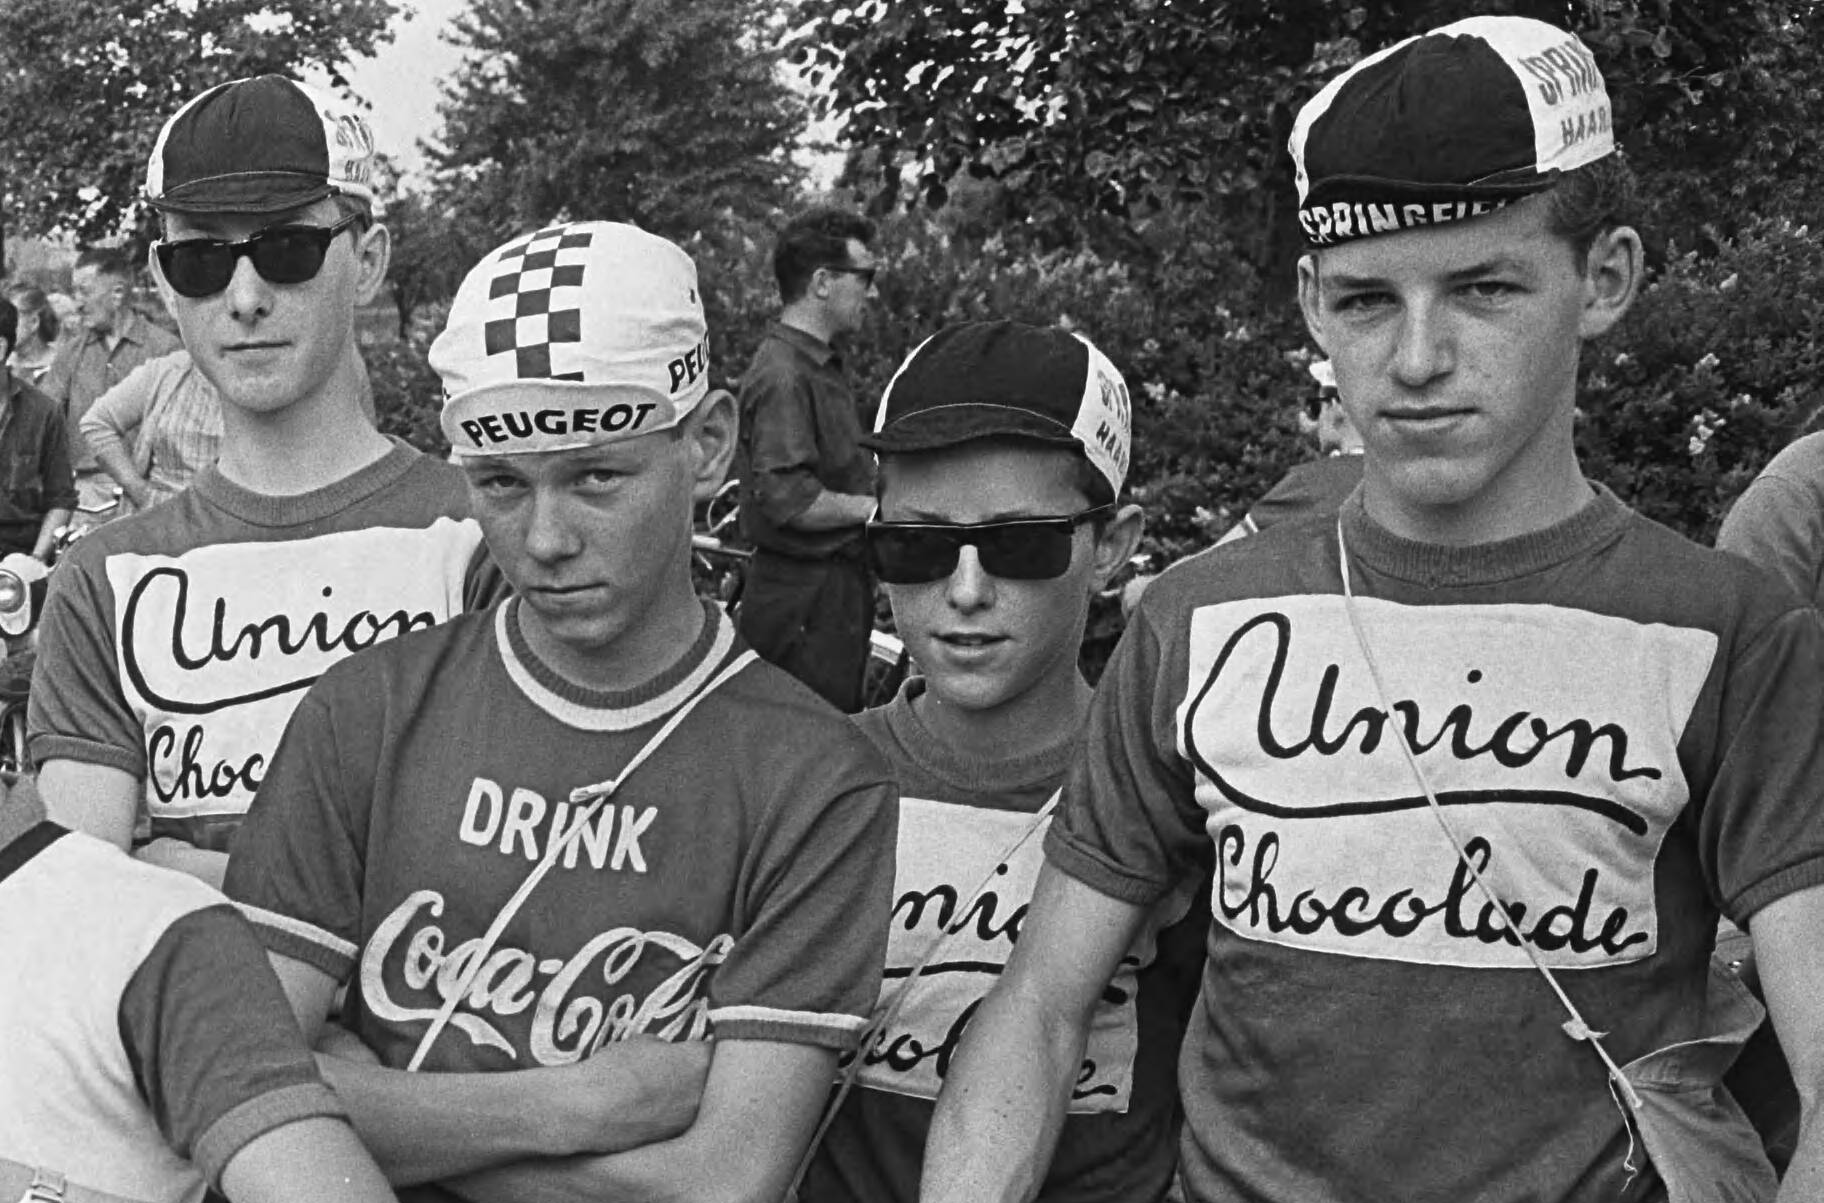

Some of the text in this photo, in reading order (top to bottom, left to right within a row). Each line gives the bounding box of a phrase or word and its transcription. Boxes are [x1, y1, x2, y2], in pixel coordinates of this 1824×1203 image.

[461, 403, 656, 448] PEUGEOT
[1184, 612, 1663, 805] Union
[459, 777, 659, 873] DRINK
[1218, 824, 1649, 957] Chocolade
